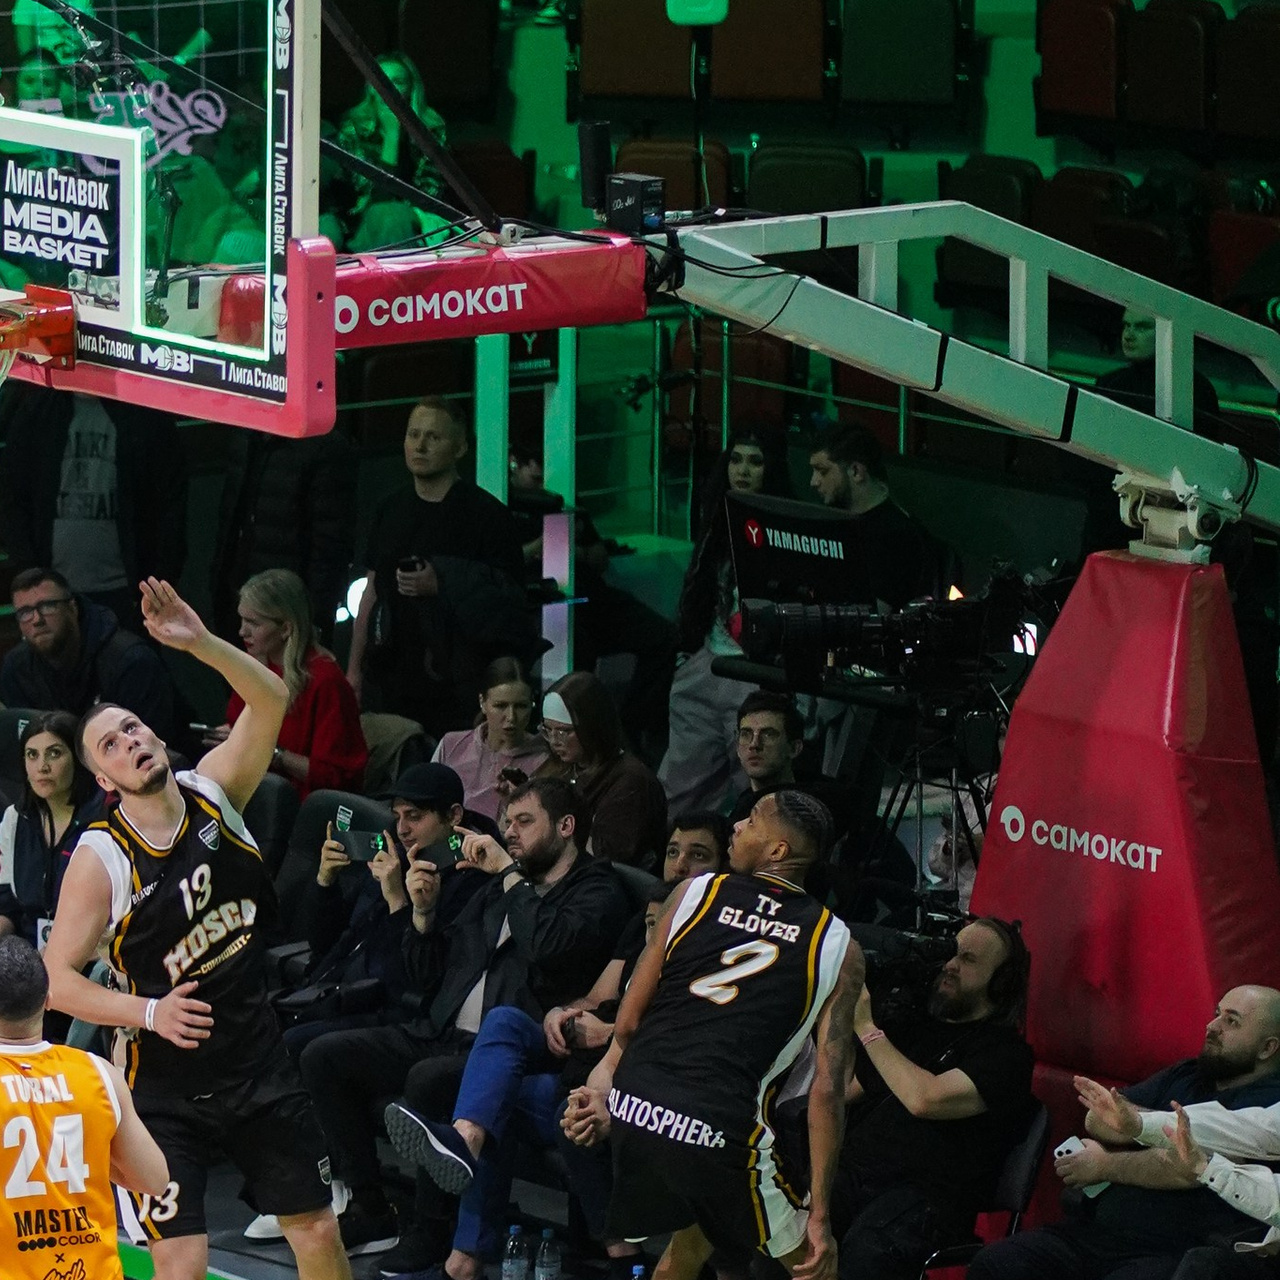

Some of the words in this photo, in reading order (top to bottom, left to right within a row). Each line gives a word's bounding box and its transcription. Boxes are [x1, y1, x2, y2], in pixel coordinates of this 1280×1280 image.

[3, 199, 109, 246] MEDIA
[3, 228, 110, 269] BASKET
[766, 527, 845, 560] YAMAGUCHI
[178, 863, 213, 921] 13
[755, 894, 782, 917] TY
[718, 906, 801, 943] GLOVER
[689, 939, 780, 1005] 2
[3, 1114, 90, 1199] 24
[13, 1206, 95, 1238] MASTER
[58, 1232, 102, 1247] COLOR
